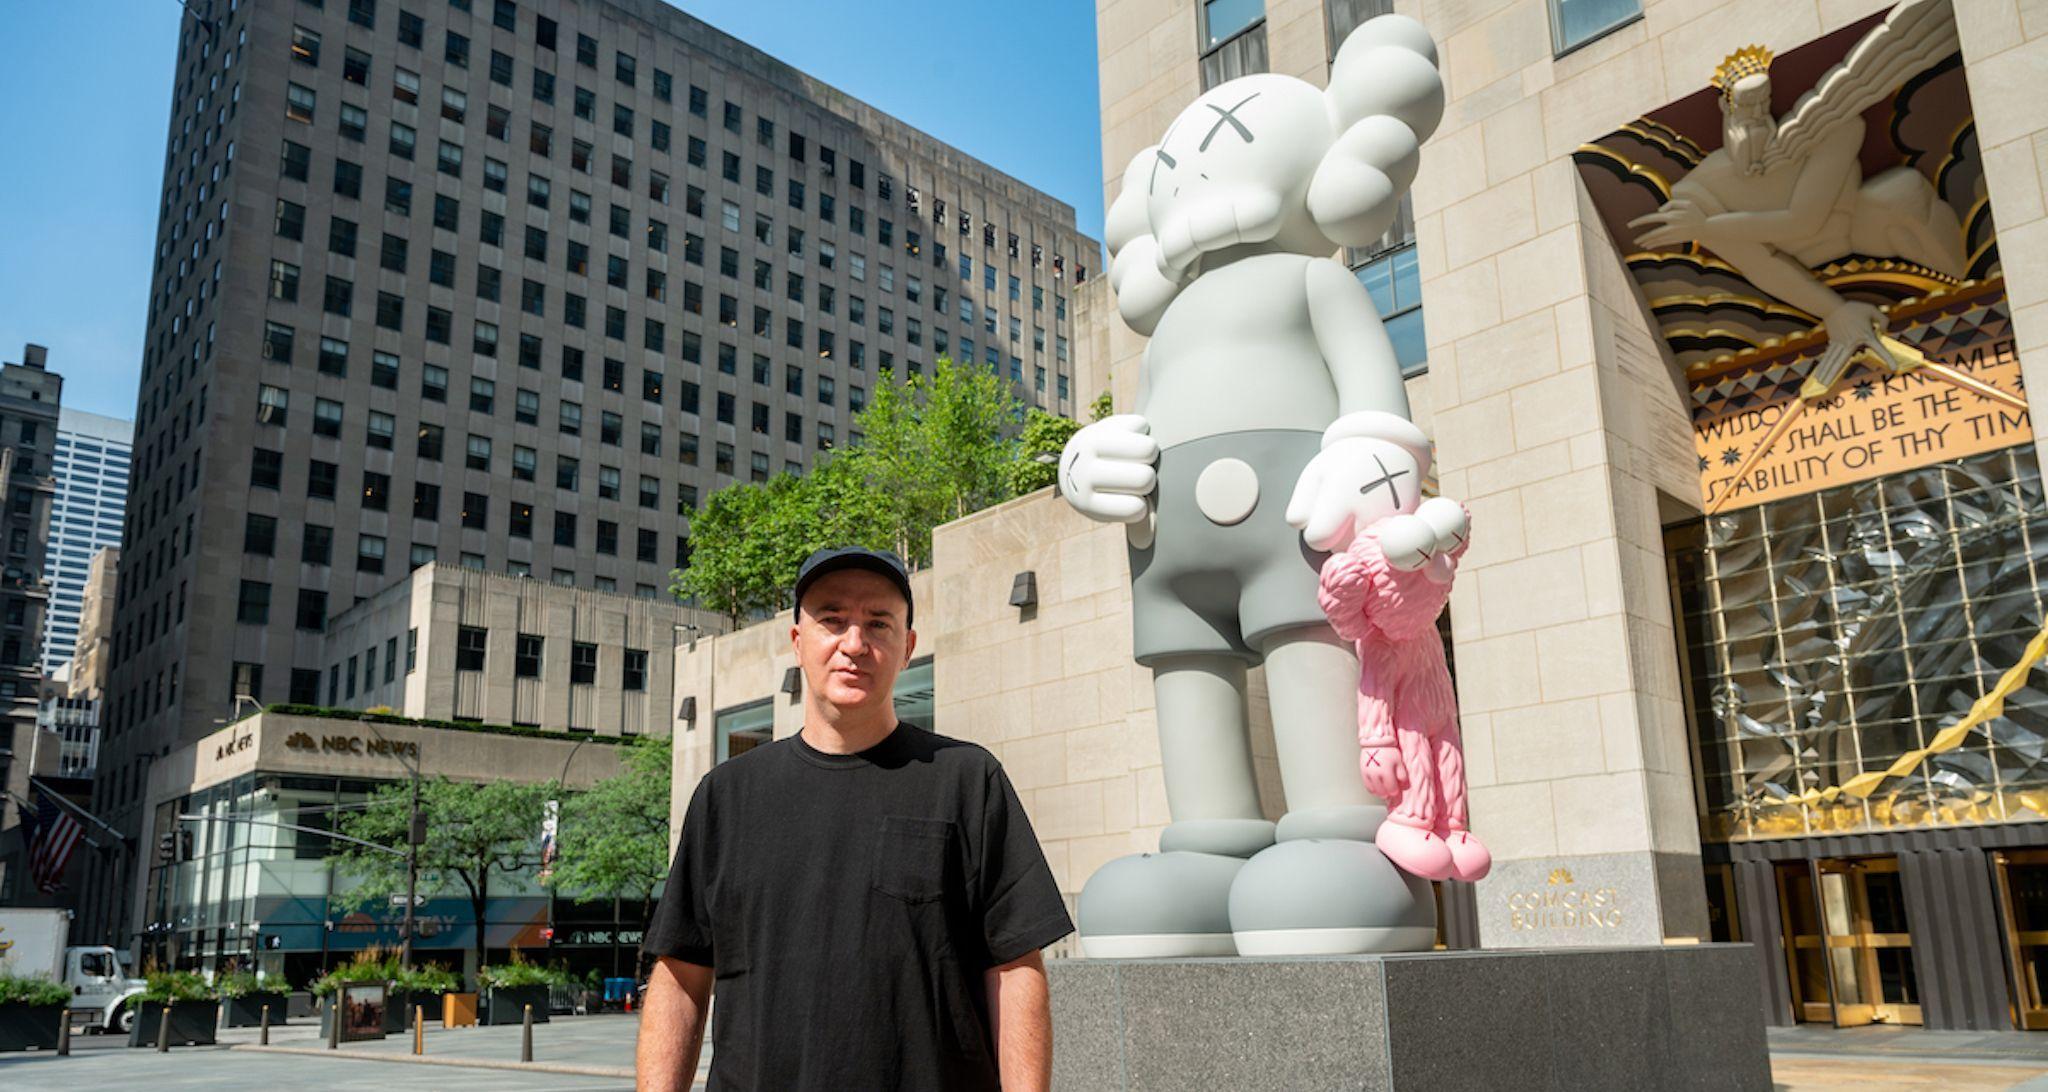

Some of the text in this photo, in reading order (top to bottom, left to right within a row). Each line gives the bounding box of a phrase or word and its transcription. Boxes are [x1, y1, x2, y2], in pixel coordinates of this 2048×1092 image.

[1882, 338, 2019, 395] KNWLE
[1786, 387, 1962, 453] SHALL BE THE
[1707, 410, 2032, 503] STABILITY OF THY TIM
[321, 735, 418, 758] NBC NEWS
[1508, 886, 1617, 911] COMCAST
[1510, 908, 1622, 932] BUILDING
[588, 931, 612, 944] NBC
